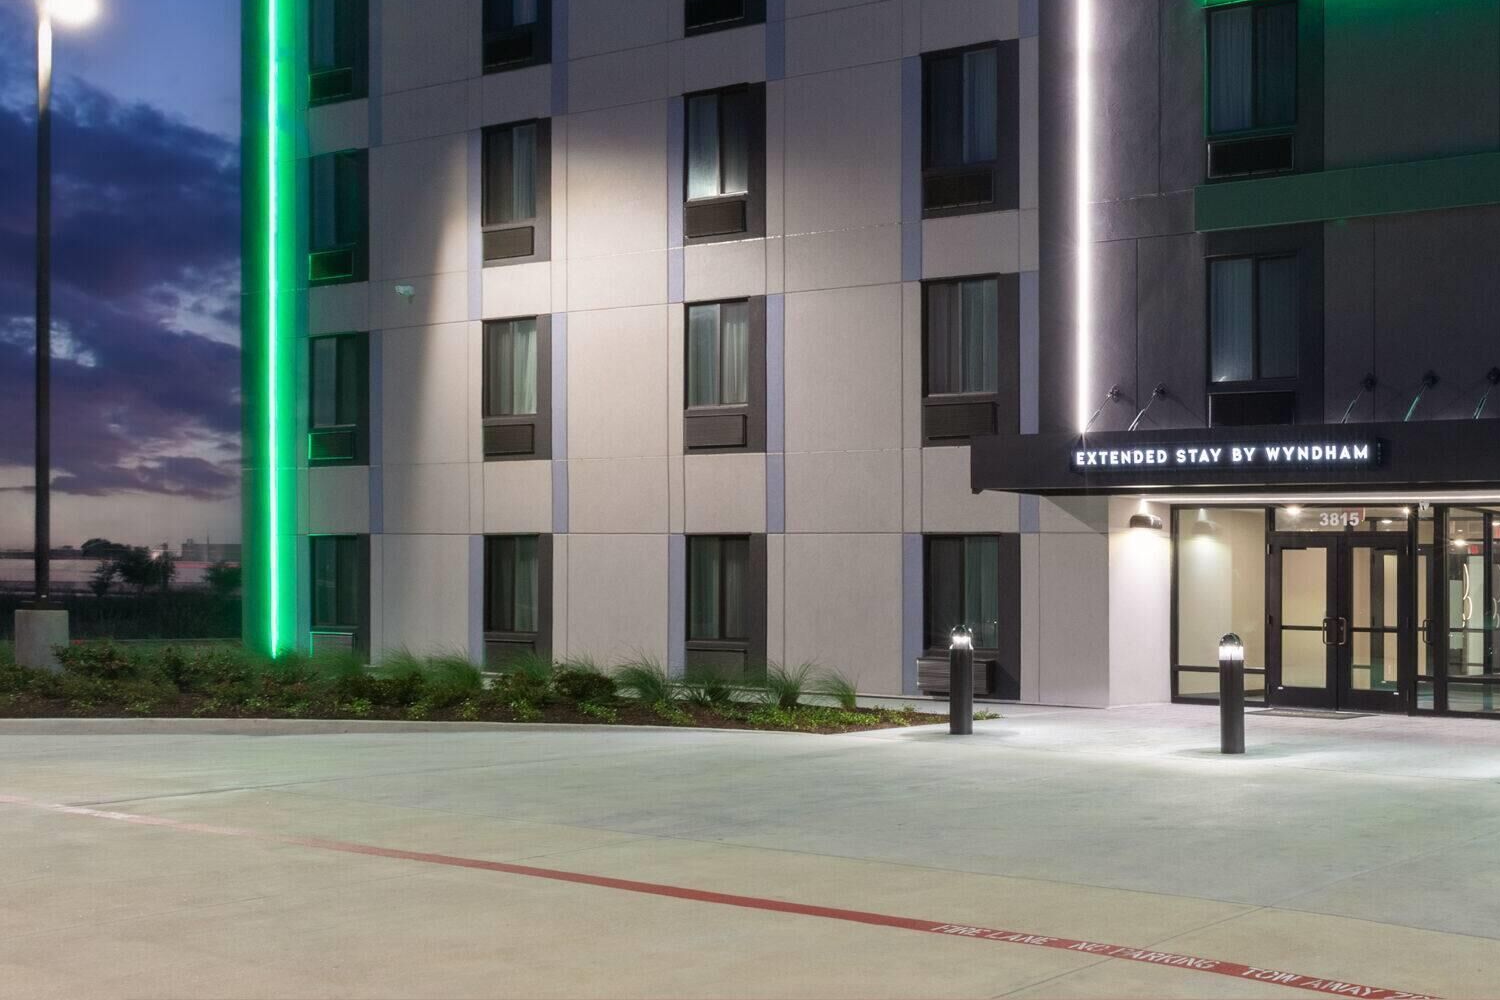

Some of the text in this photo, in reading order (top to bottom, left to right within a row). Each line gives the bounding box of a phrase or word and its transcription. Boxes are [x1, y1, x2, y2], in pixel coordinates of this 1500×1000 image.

[1076, 444, 1369, 465] EXTENDED STAY BY WYNDHAM
[1319, 512, 1360, 527] 3815
[930, 924, 991, 937] FIRE
[985, 931, 1059, 945] LANE
[1068, 942, 1110, 952] NO
[1108, 947, 1221, 969] PARKING
[1242, 967, 1302, 984] TOW
[1300, 978, 1385, 997] AWAY
